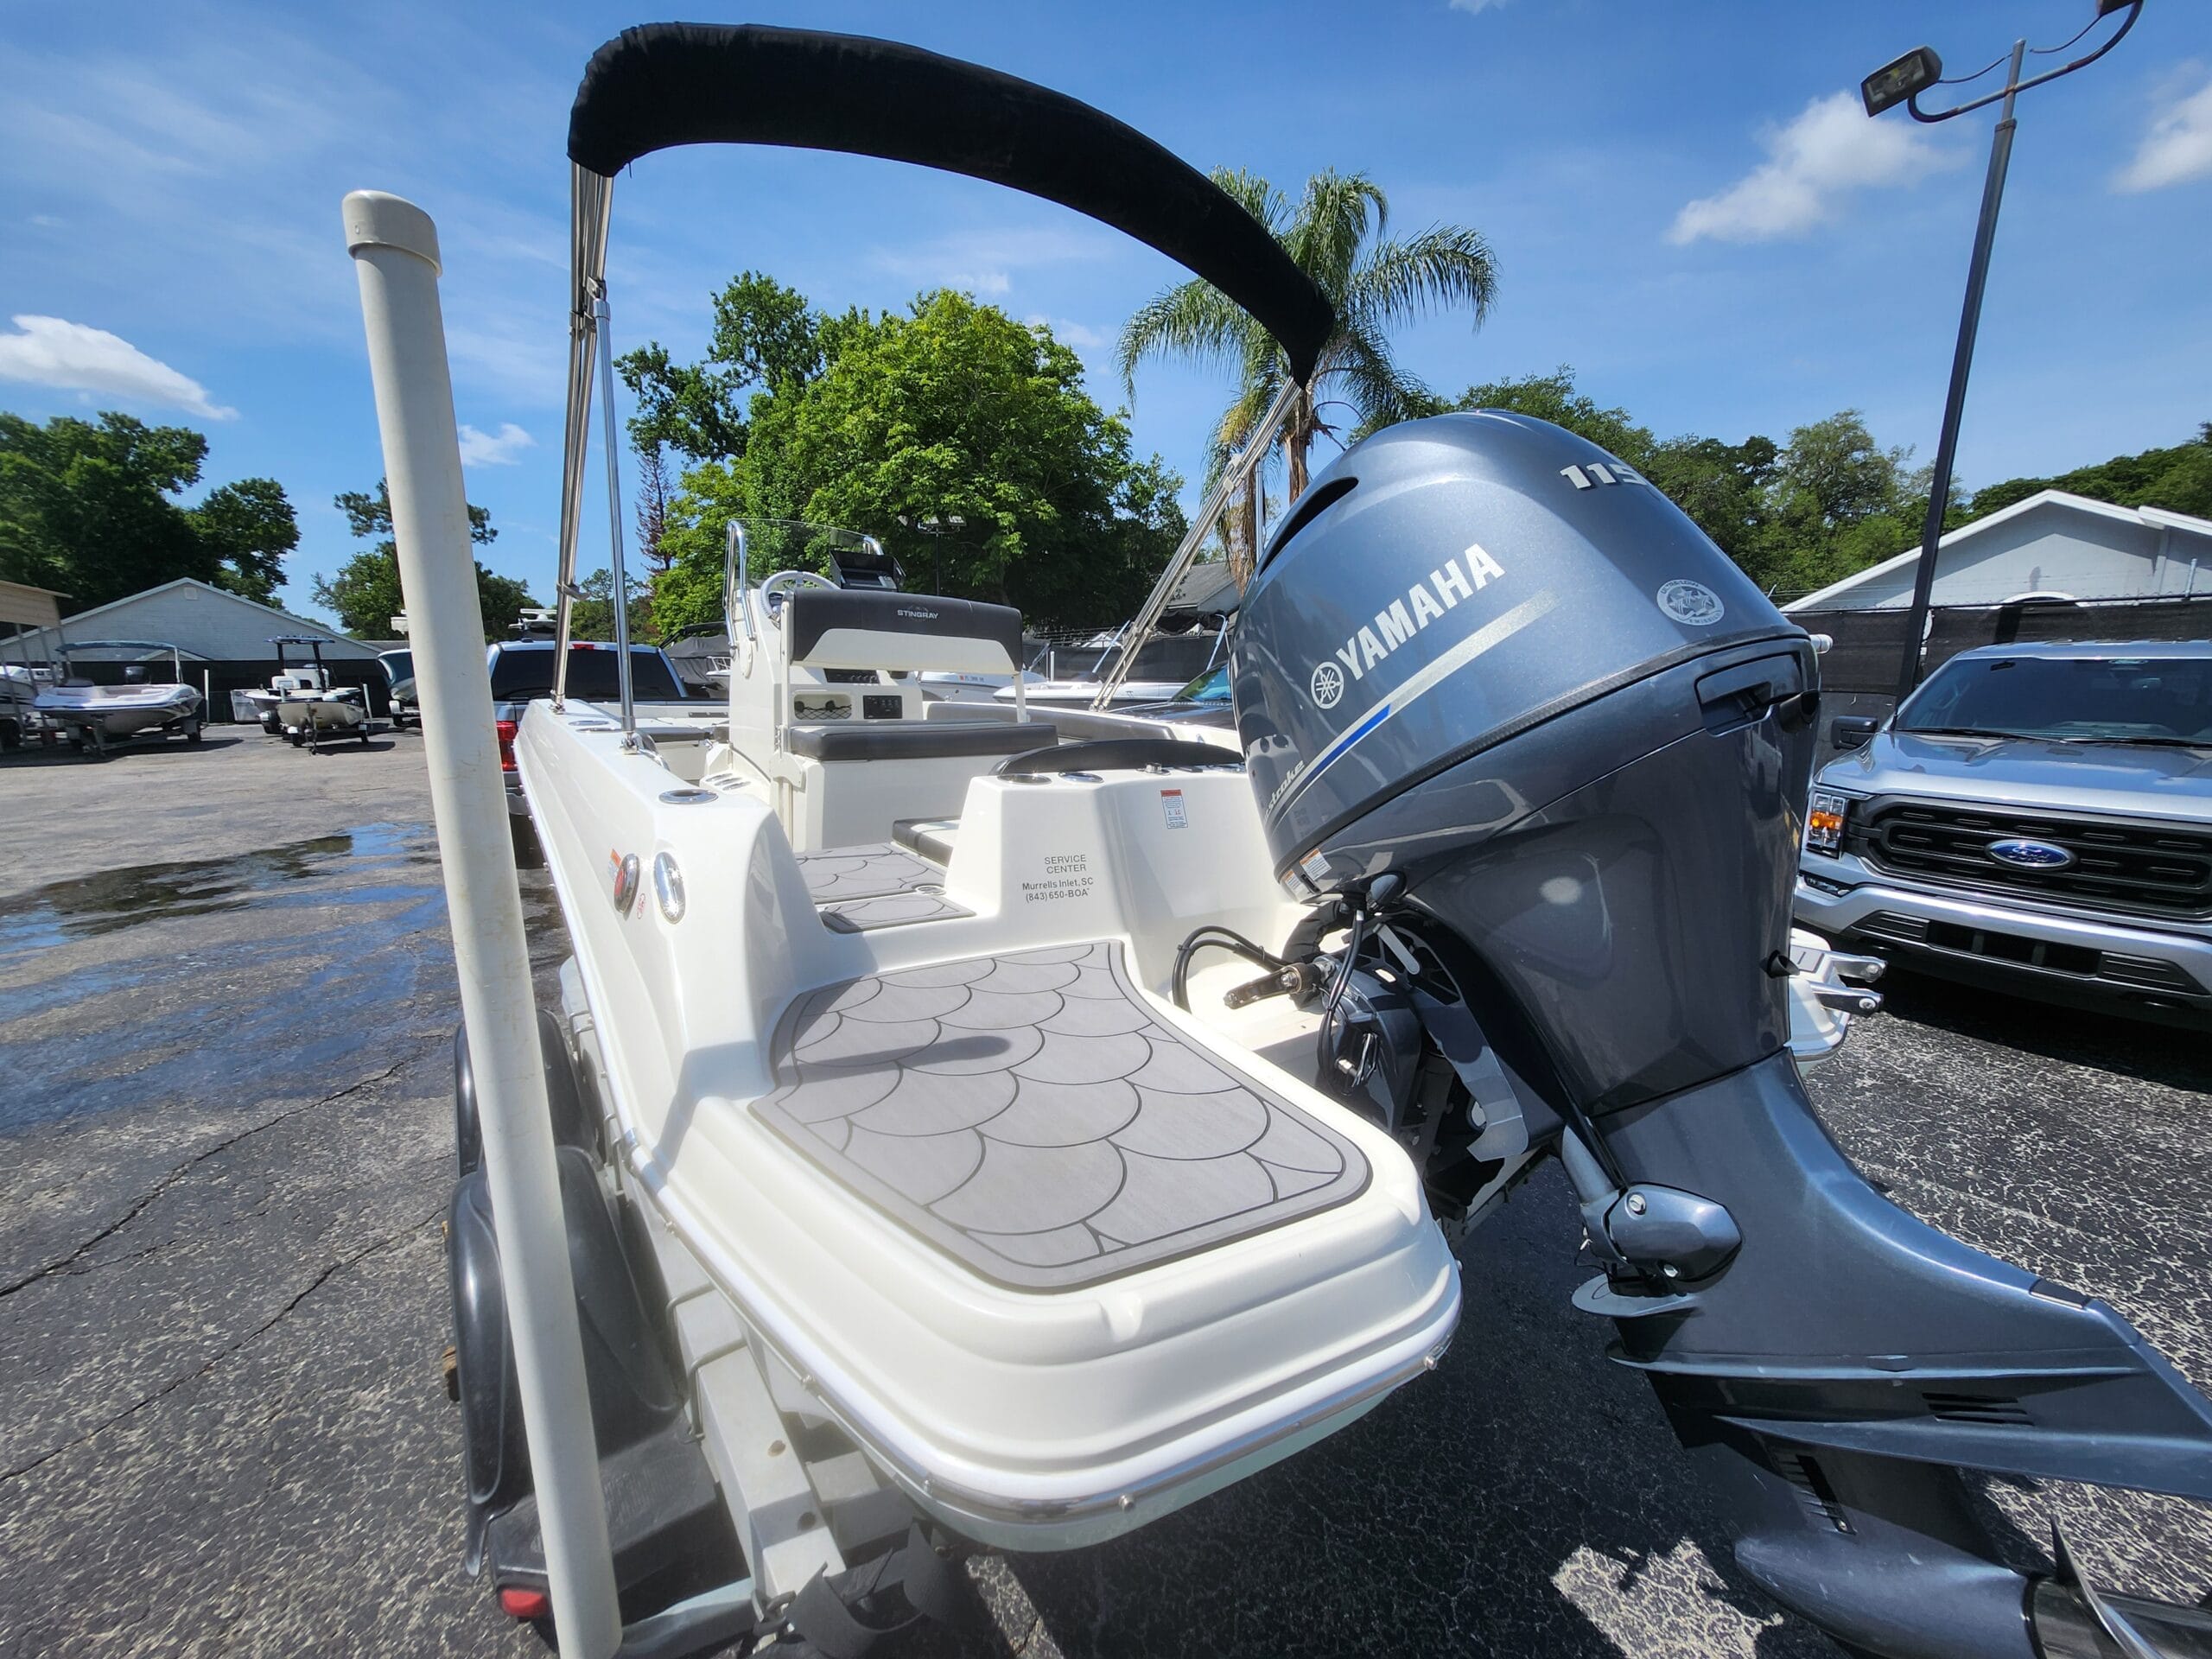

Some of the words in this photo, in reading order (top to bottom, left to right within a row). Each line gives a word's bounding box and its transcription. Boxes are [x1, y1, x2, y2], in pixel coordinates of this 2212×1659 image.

[1560, 462, 1647, 490] 115
[897, 609, 938, 620] STINGRAY
[1335, 543, 1506, 681] YAMAHA
[1044, 854, 1087, 865] SERVICE
[2006, 847, 2051, 863] Ford
[1046, 863, 1087, 874] CENTER
[1022, 880, 1058, 891] Murrells
[1081, 876, 1094, 886] SC
[1026, 892, 1048, 904] (843)
[1048, 887, 1090, 899] 650-BOA
